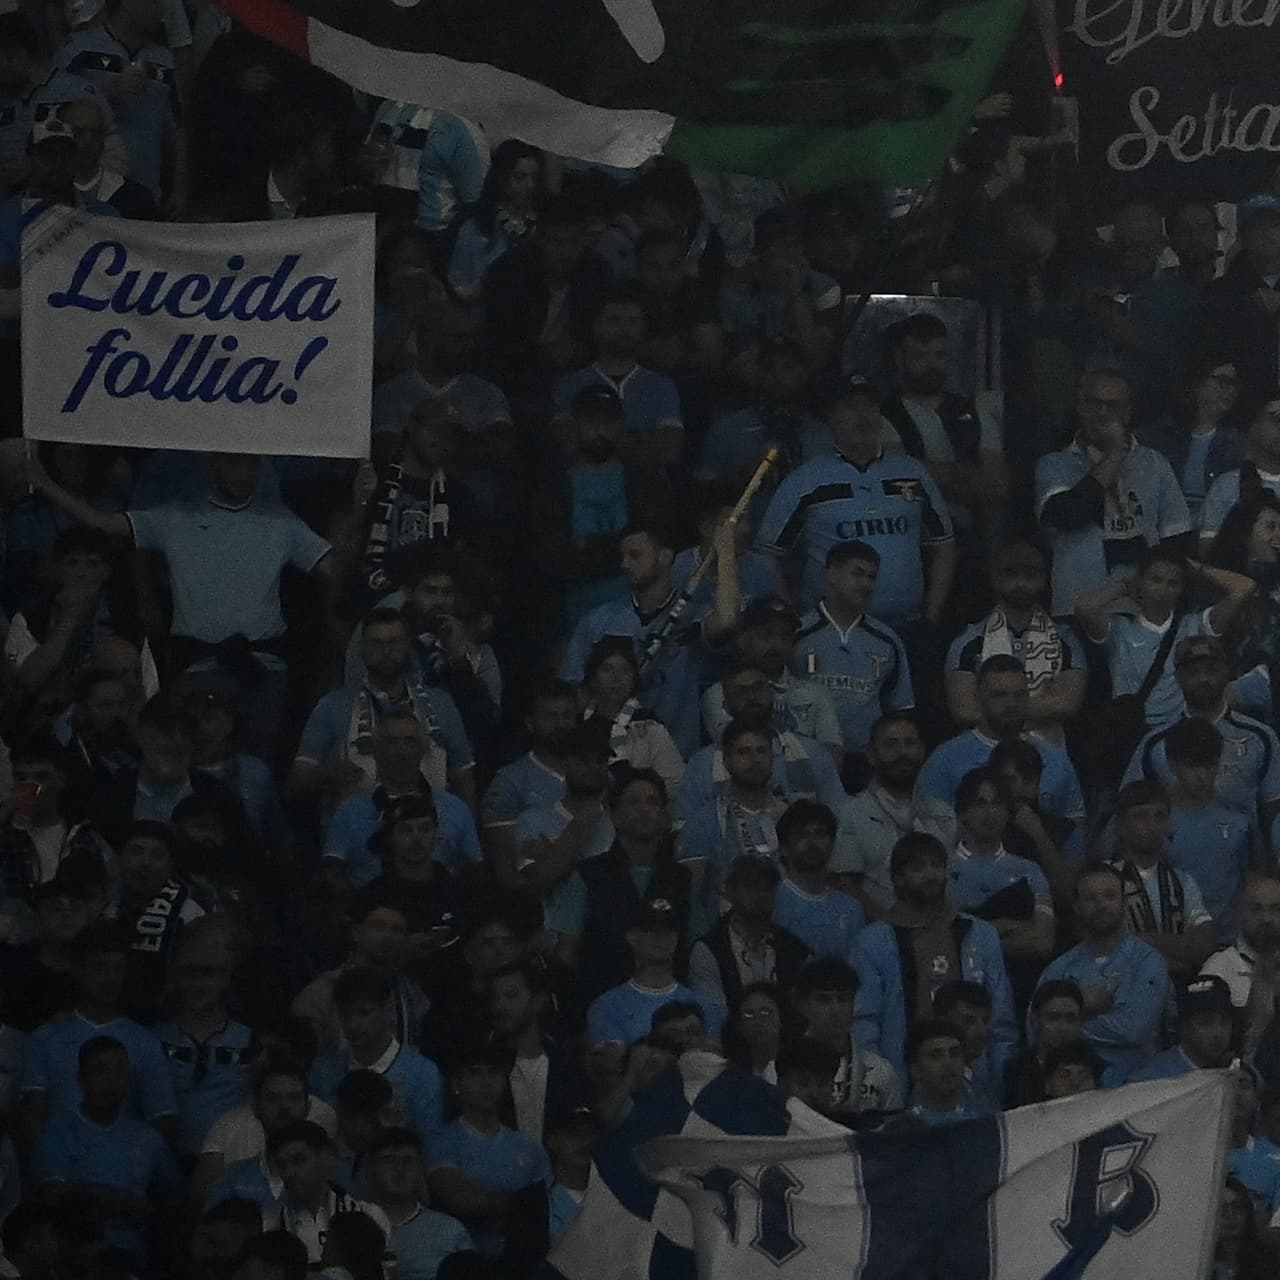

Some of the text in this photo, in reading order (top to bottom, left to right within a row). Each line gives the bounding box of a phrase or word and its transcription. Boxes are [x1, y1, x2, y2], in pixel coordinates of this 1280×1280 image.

[47, 239, 342, 322] Lucida
[61, 327, 329, 414] follia!
[835, 516, 910, 540] CIRIO
